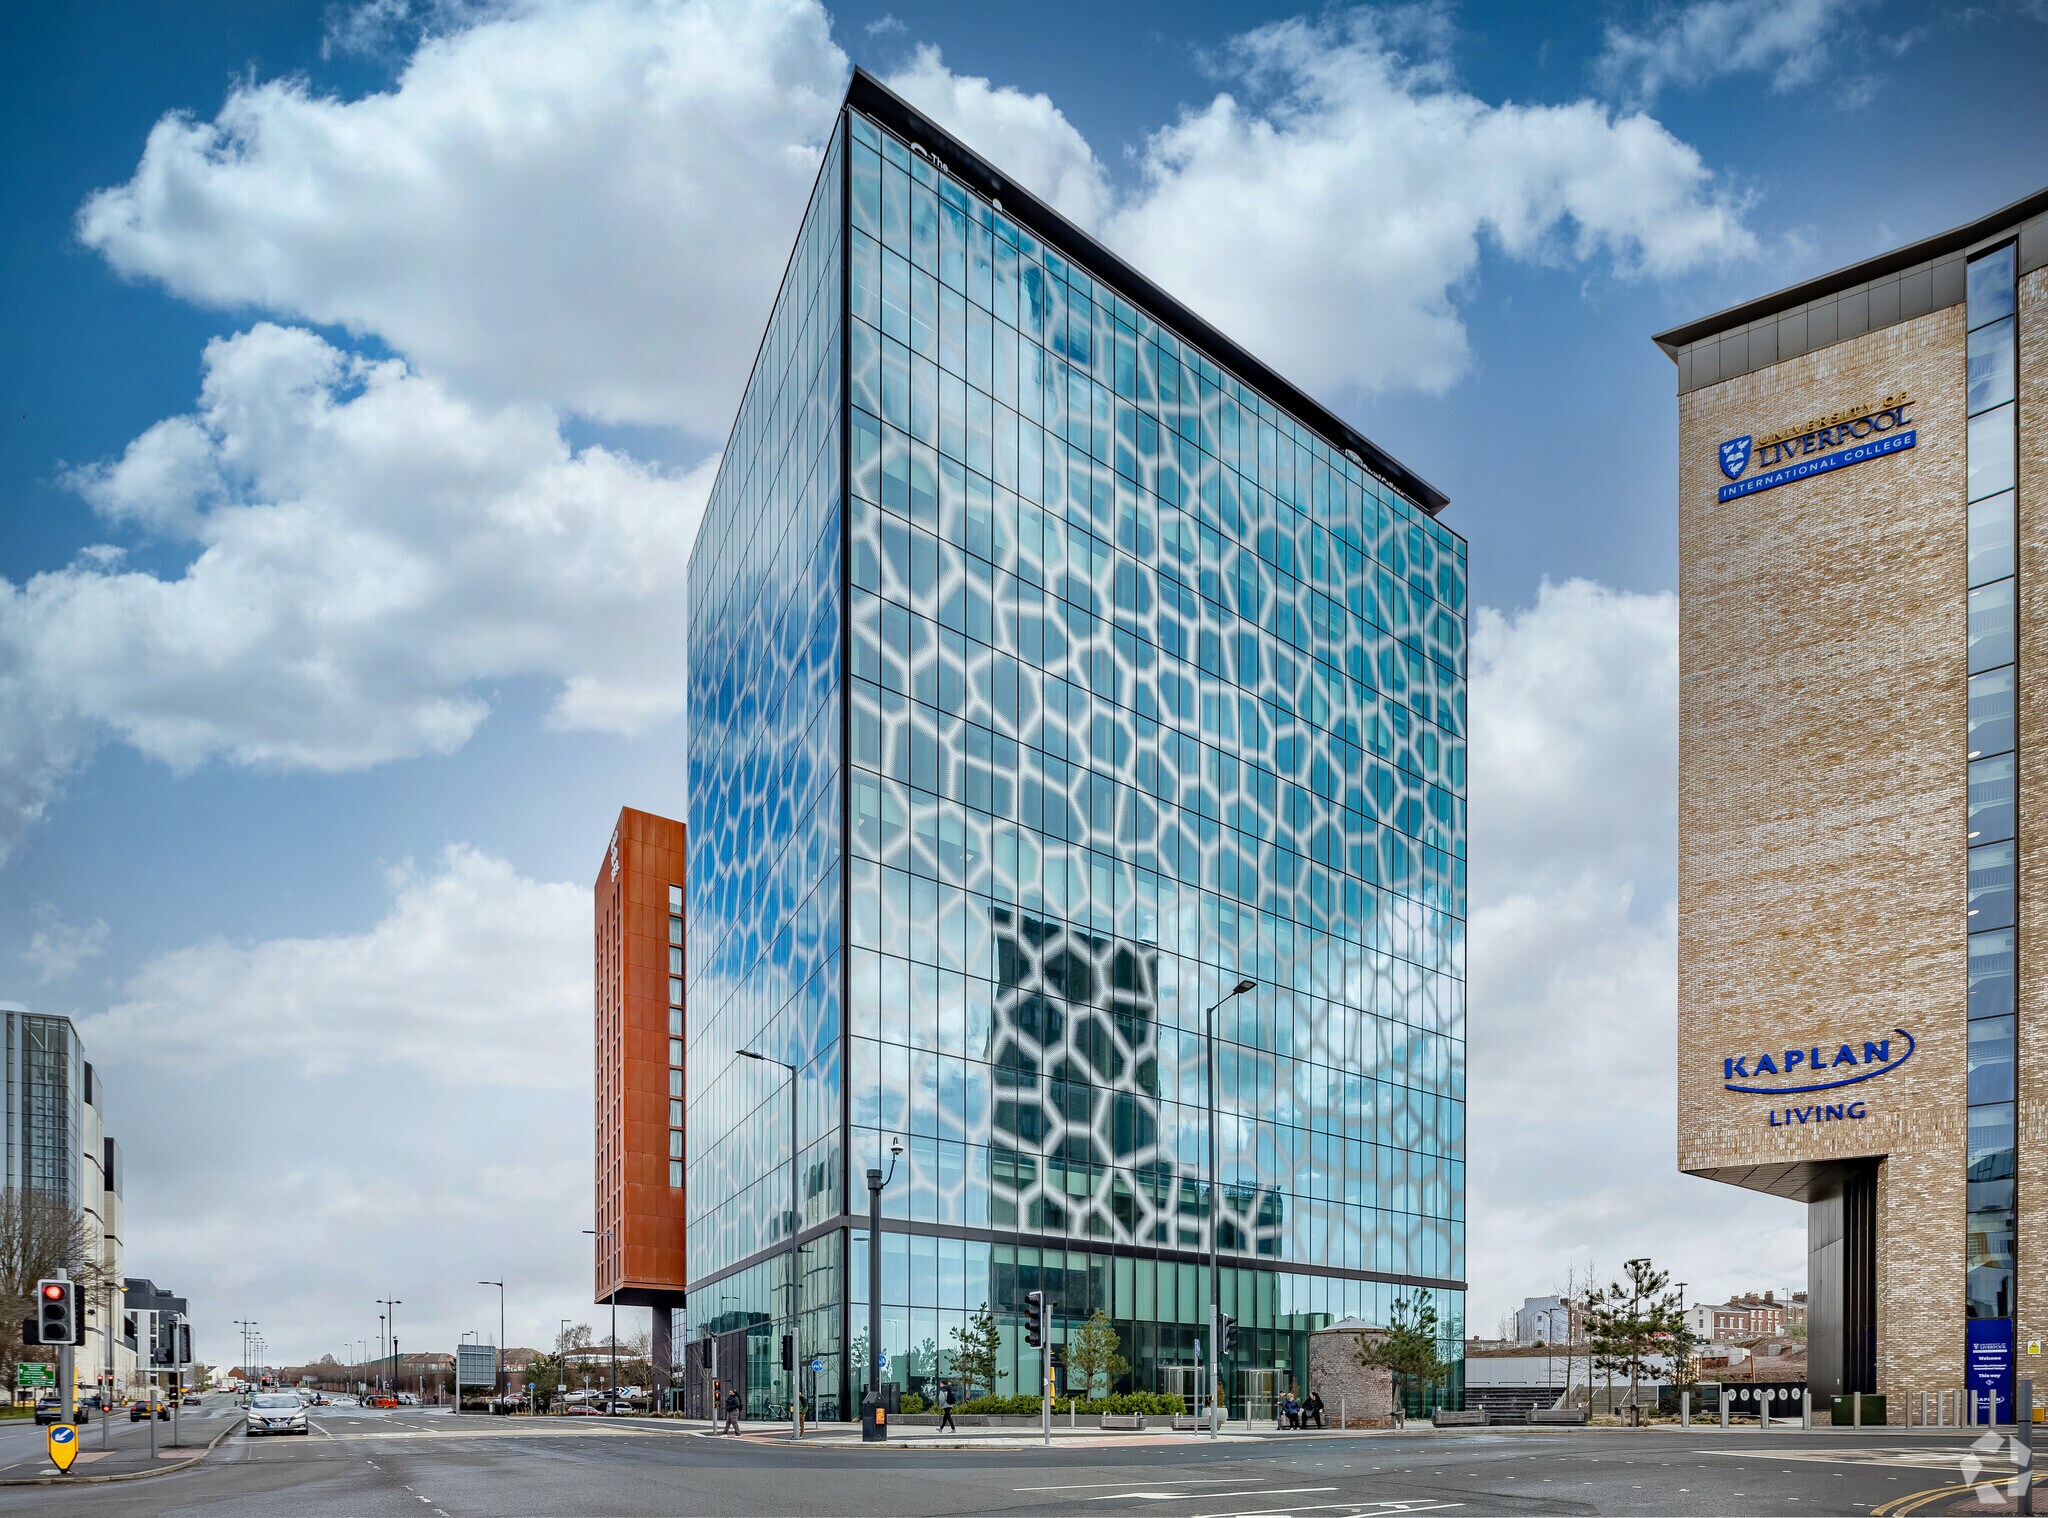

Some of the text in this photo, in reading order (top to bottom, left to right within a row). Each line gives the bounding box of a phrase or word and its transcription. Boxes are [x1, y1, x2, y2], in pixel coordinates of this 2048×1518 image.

[931, 152, 949, 173] The
[1758, 391, 1908, 446] UNIVERSITY OF
[1759, 406, 1913, 468] LIVERPOOL
[1722, 434, 1912, 498] INTERNATIONAL COLLEGE
[1724, 1039, 1889, 1079] KAPLAN
[1769, 1101, 1867, 1127] LIVING
